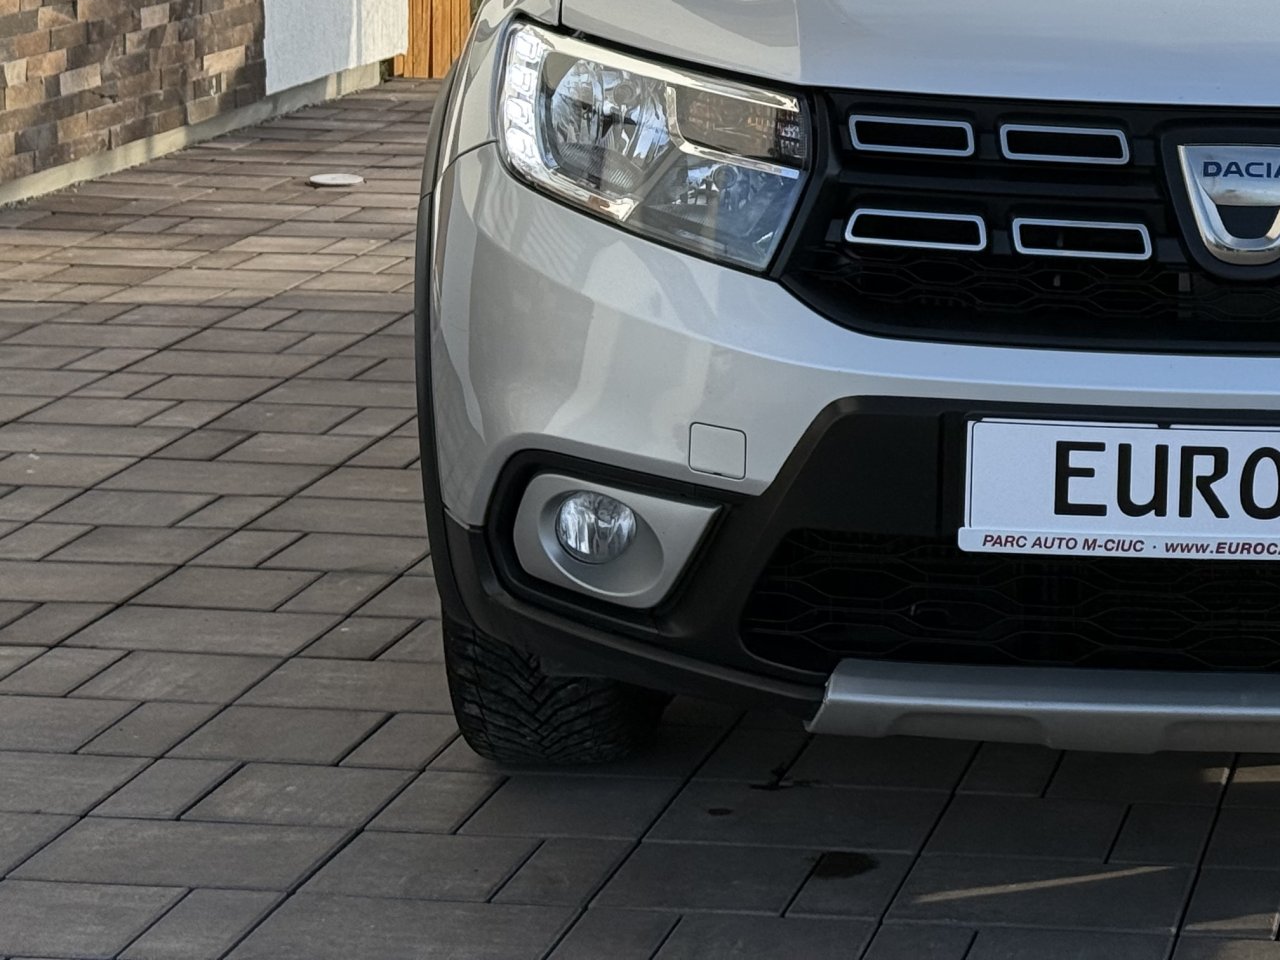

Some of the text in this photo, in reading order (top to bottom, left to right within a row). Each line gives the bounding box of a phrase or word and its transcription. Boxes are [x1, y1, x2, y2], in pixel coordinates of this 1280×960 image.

[982, 534, 1028, 548] PARC
[1031, 536, 1078, 550] AUTO
[1081, 538, 1145, 552] M-CIUC
